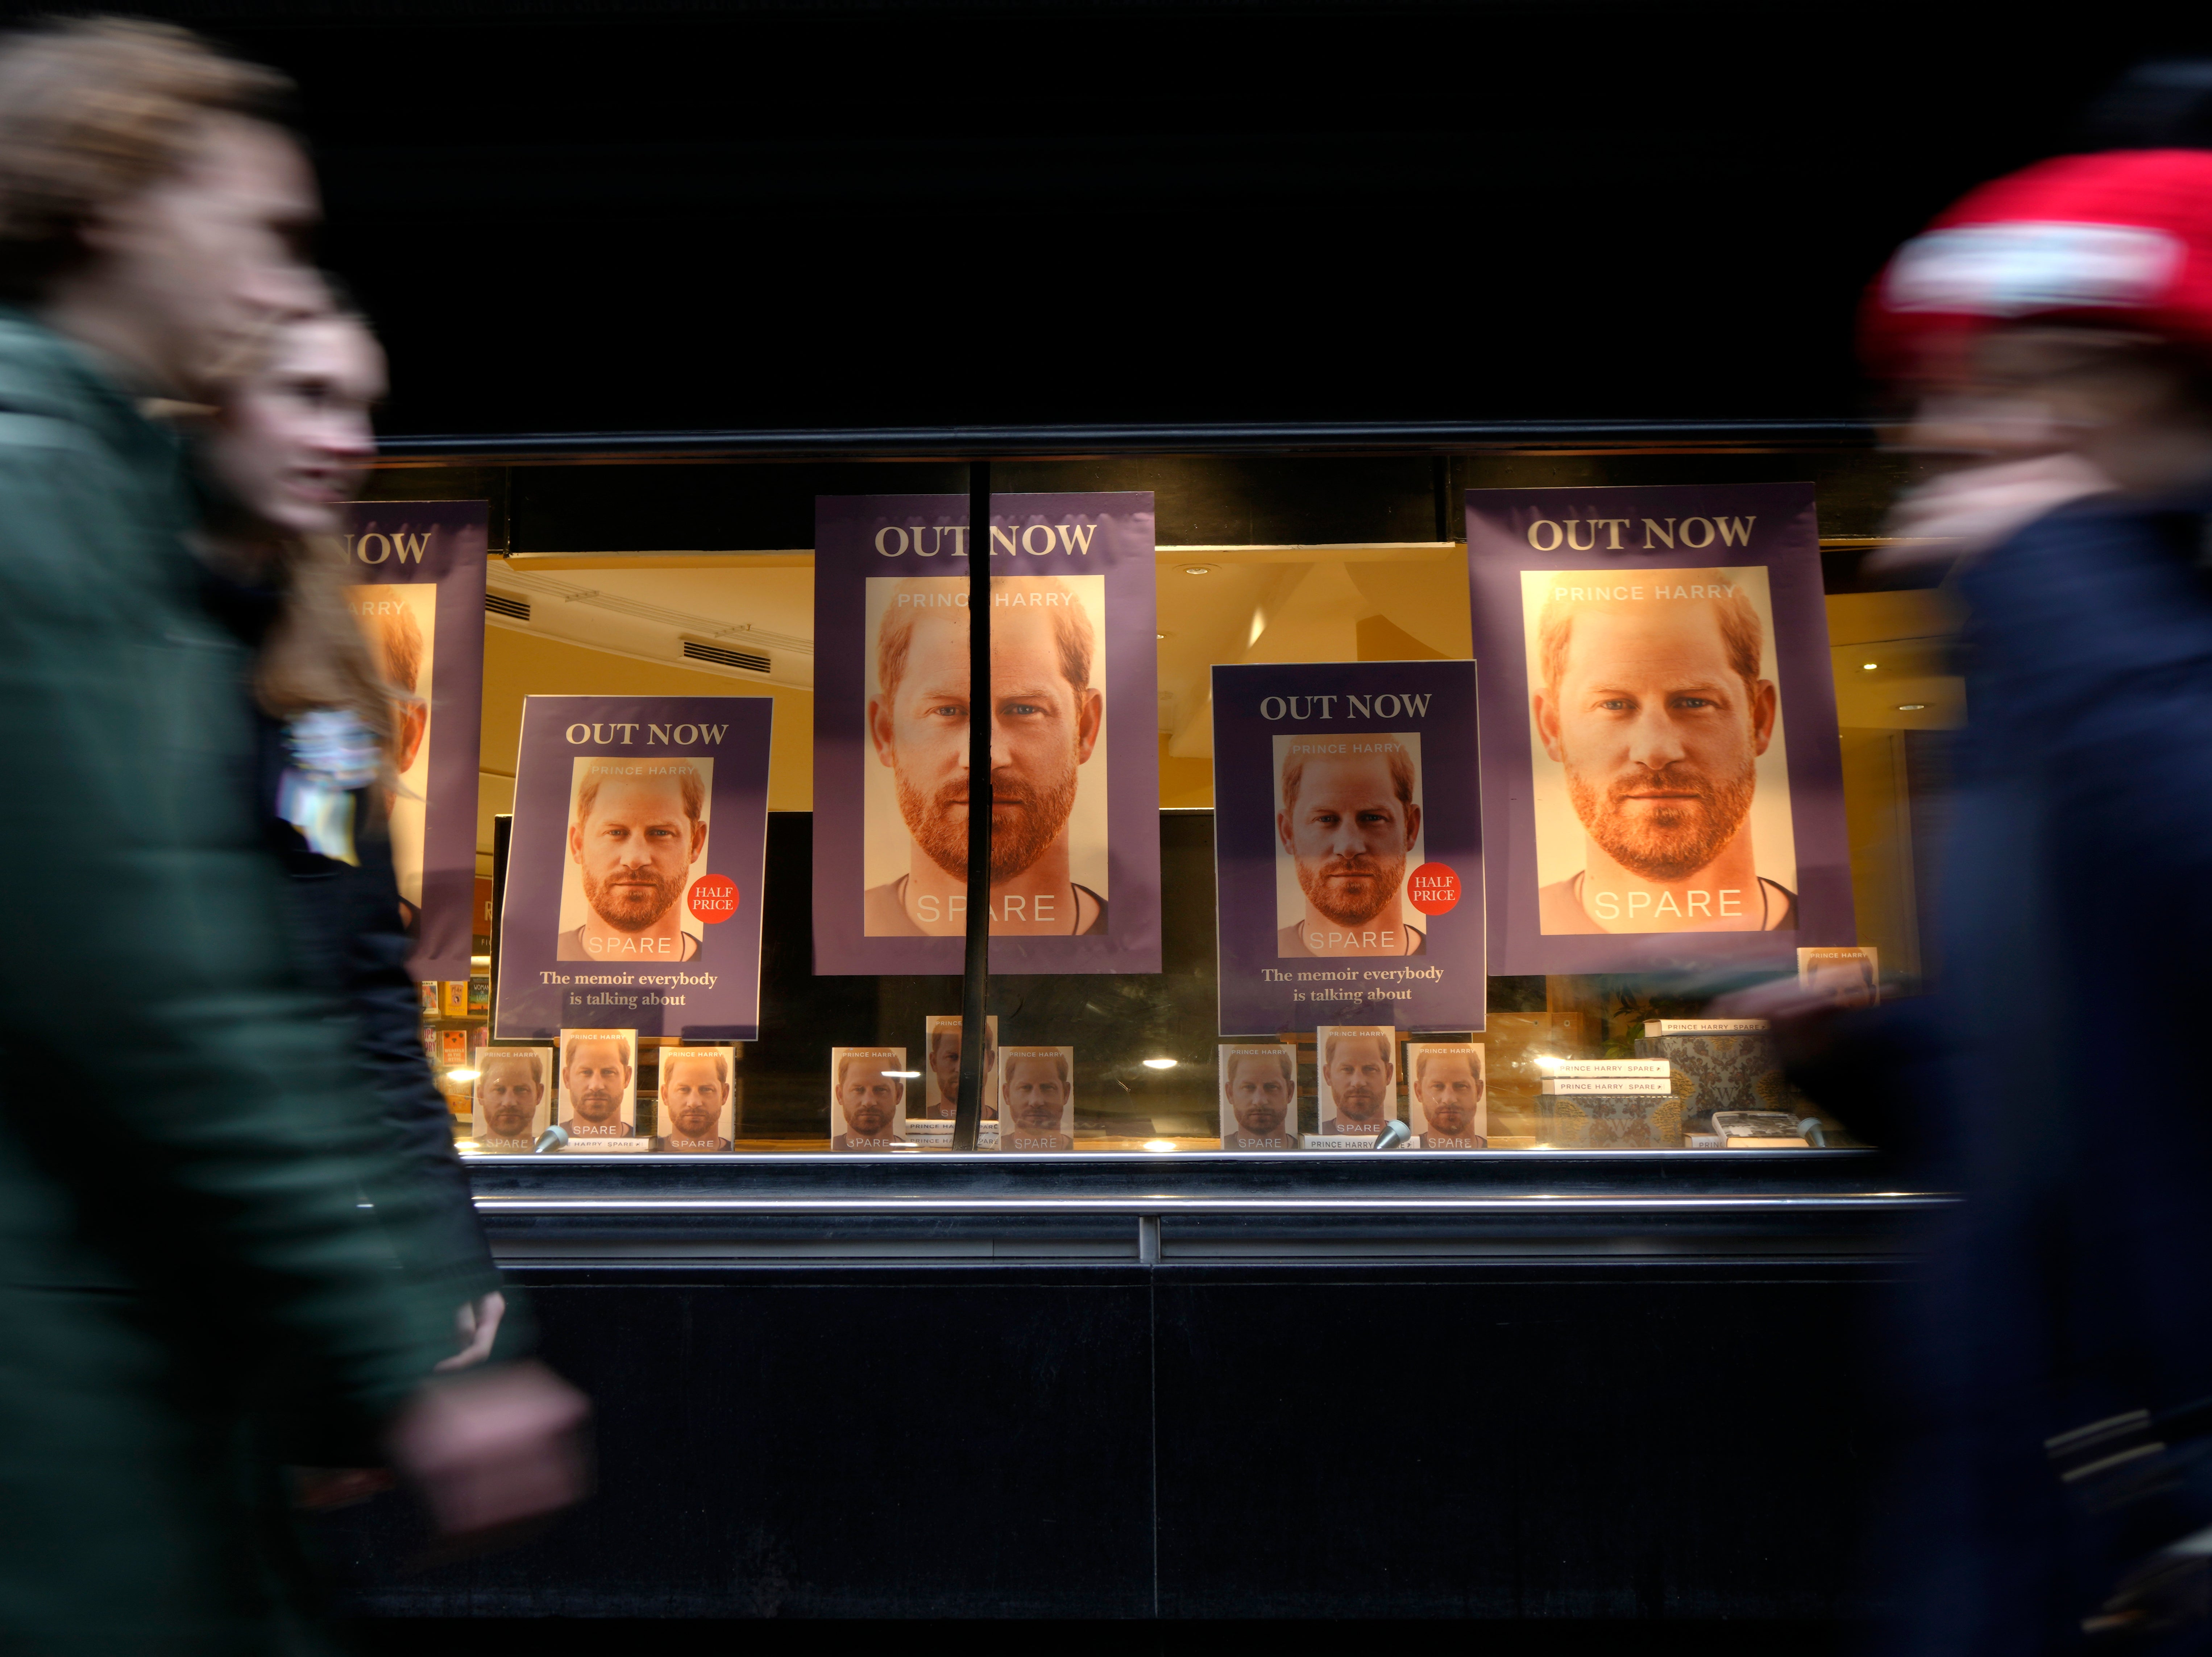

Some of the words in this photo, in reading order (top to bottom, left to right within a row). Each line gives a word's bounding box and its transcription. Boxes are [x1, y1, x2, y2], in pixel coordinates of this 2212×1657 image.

[875, 526, 969, 557] OUT
[990, 524, 1097, 556] NOW
[1527, 519, 1630, 551] OUT
[1642, 516, 1756, 549] NOW
[329, 533, 431, 564] NOW
[1556, 586, 1644, 601] PRINCE
[1655, 584, 1737, 599] HARRY
[898, 593, 969, 607] PRINC
[995, 593, 1073, 606] HARRY
[348, 601, 405, 615] ARRY
[1260, 696, 1337, 720] OUT
[1346, 694, 1432, 718] NOW
[566, 724, 638, 745] OUT
[647, 724, 729, 746] NOW
[1293, 744, 1346, 753] PRINCE
[1353, 743, 1401, 752] HARRY
[592, 766, 643, 775] PRINCE
[649, 766, 695, 775] HARRY
[1415, 876, 1453, 888] HALF
[696, 887, 733, 898] HALF
[1413, 890, 1456, 902] PRICE
[692, 900, 734, 911] PRICE
[1595, 889, 1742, 919] SPARE
[589, 937, 671, 953] SPARE
[1310, 931, 1394, 949] SPARE
[540, 972, 570, 984] The
[575, 972, 635, 984] memoir
[639, 972, 718, 989] everybody
[1262, 969, 1292, 982] The
[1298, 968, 1359, 981] memoir
[1364, 966, 1444, 983] everybody
[570, 993, 582, 1005] is
[587, 993, 637, 1009] talking
[642, 994, 686, 1005] about
[1294, 990, 1306, 1001] is
[1311, 989, 1362, 1004] talking
[1368, 988, 1412, 1000] about
[573, 1126, 616, 1134] SPARE
[486, 1138, 528, 1148] SPARE
[847, 1139, 889, 1147] SPARE
[1015, 1138, 1057, 1149] SPARE
[1239, 1138, 1281, 1148] SPARE
[1429, 1138, 1472, 1148] SPARE
